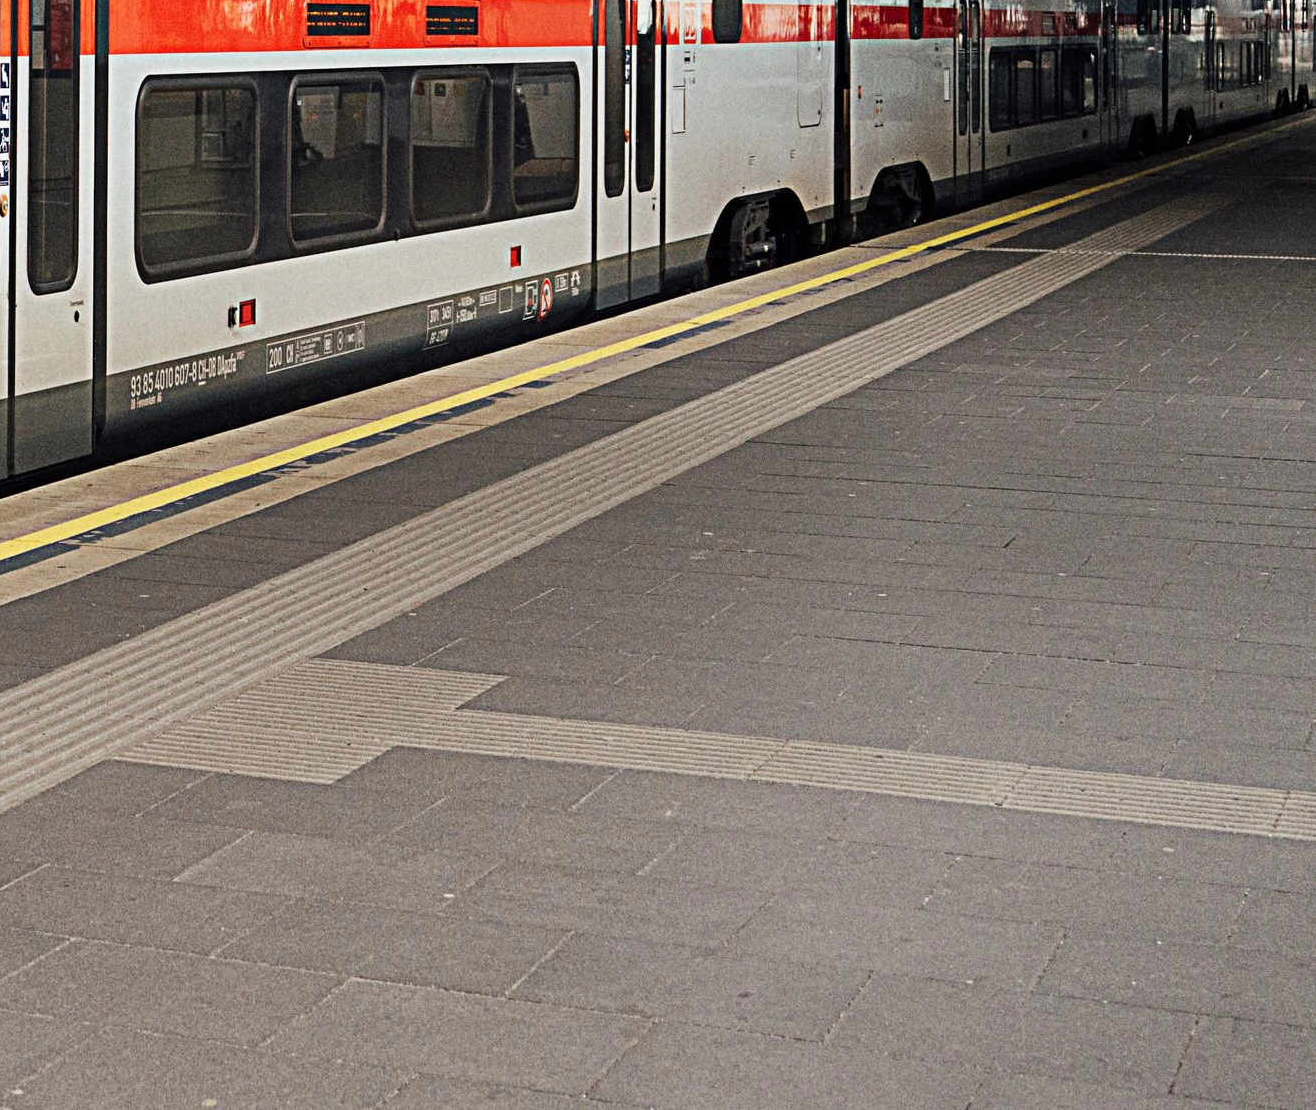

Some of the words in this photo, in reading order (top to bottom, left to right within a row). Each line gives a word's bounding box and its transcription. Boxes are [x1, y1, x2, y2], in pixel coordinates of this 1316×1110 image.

[269, 346, 283, 368] 200
[130, 375, 142, 398] 93
[142, 371, 154, 394] 85
[154, 367, 174, 390] 4010
[174, 361, 197, 386] 607-8
